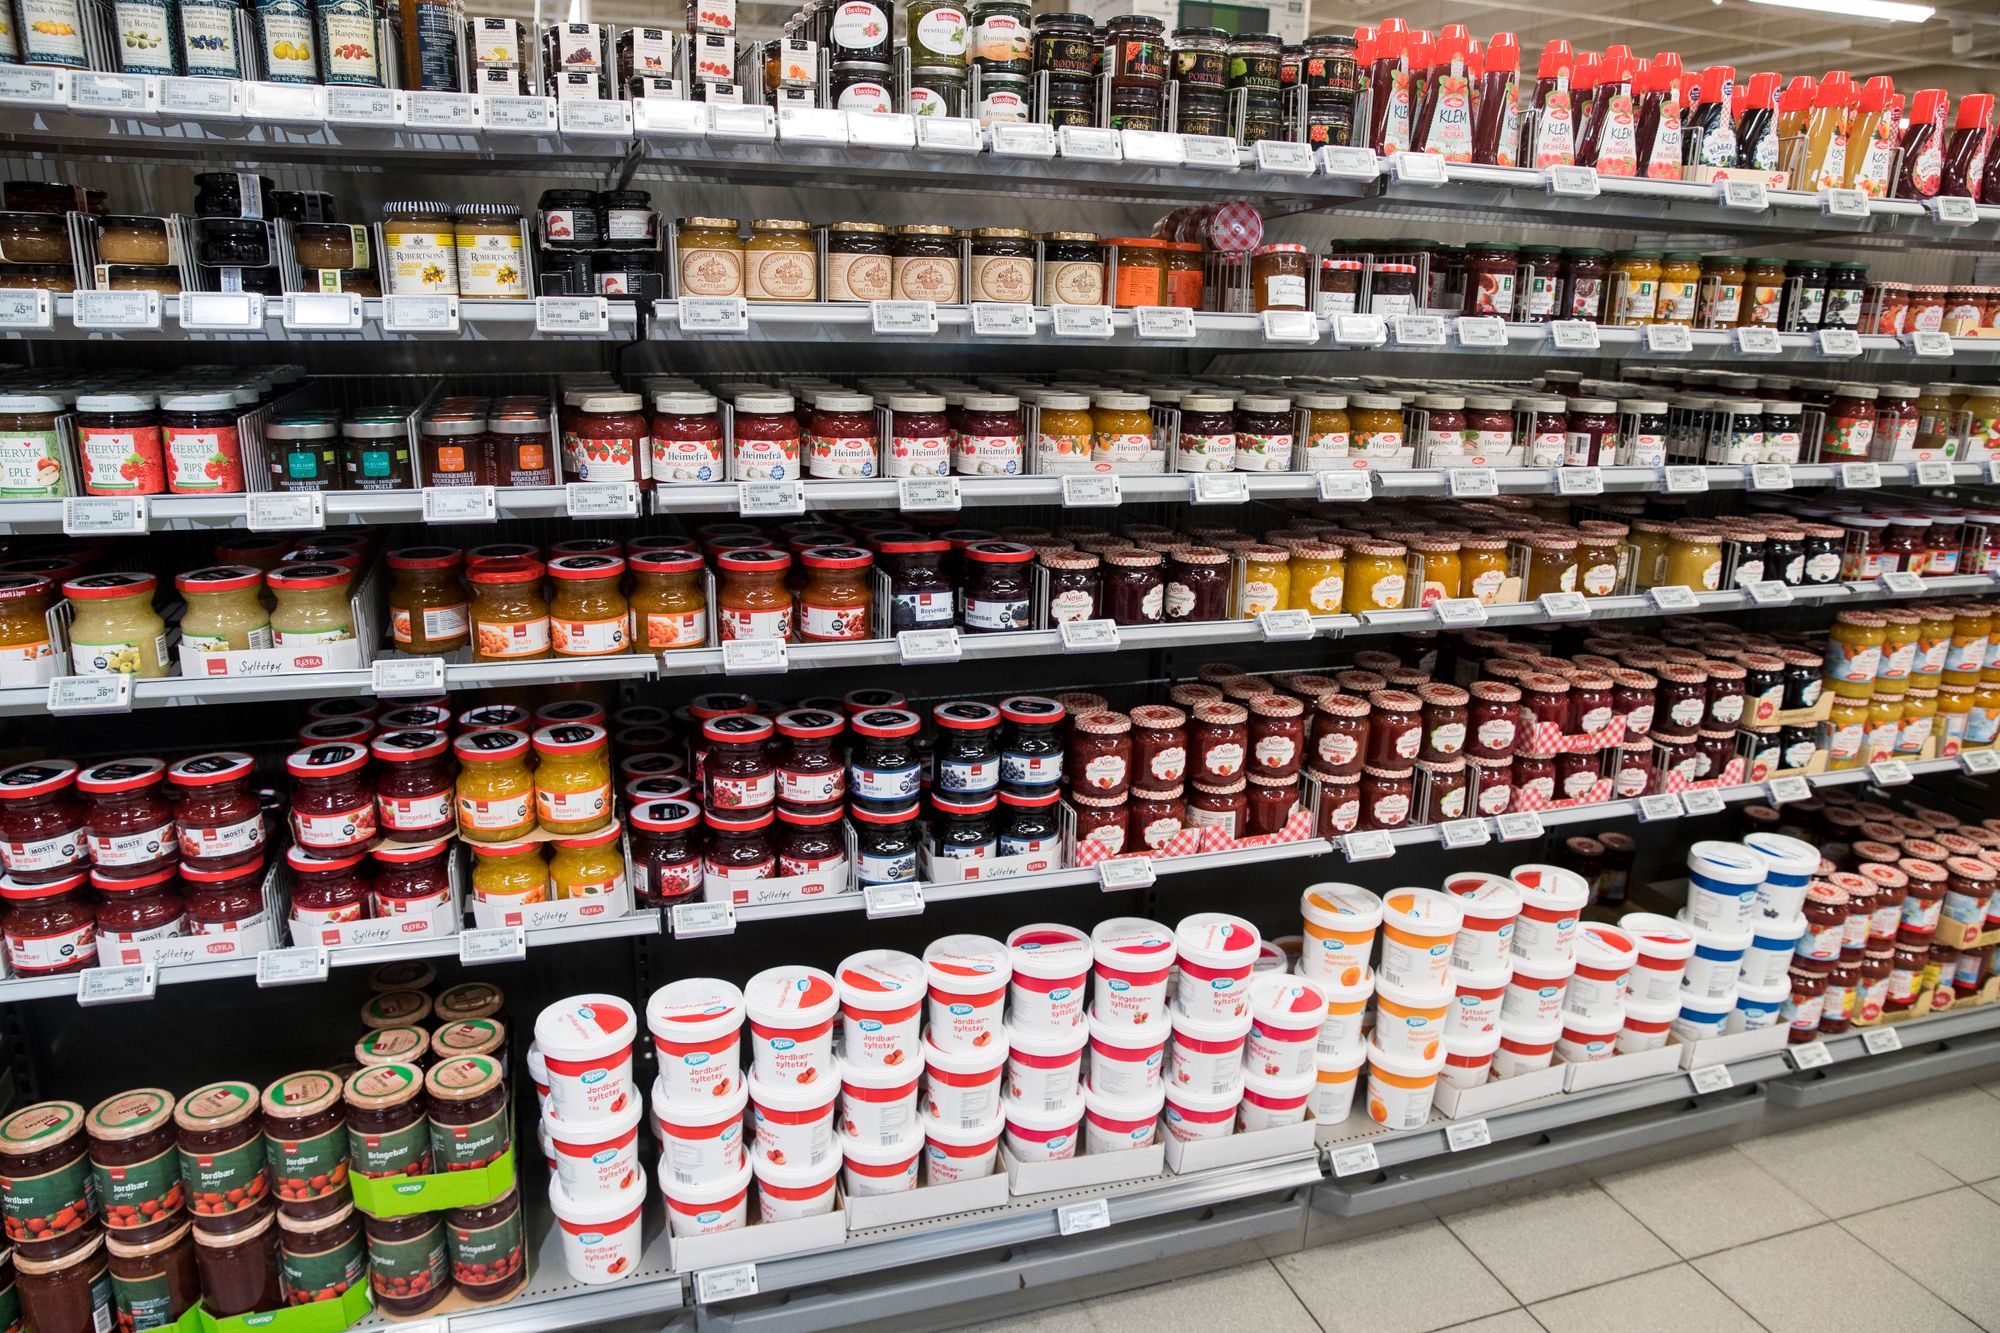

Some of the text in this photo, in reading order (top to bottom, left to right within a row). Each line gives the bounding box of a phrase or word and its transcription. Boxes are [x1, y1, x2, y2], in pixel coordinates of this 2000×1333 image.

[845, 5, 871, 16] Baxters
[936, 12, 960, 23] Baxters
[134, 20, 158, 29] Royale
[198, 21, 229, 33] Blueberry
[990, 20, 1014, 30] Baxters
[268, 29, 294, 39] Imperial
[335, 29, 369, 42] Raspberry
[854, 87, 880, 97] Baxters
[992, 95, 1017, 106] Baxters
[1439, 108, 1467, 124] KLEM
[1547, 123, 1570, 136] KLEM
[1610, 127, 1631, 140] KLEM
[88, 444, 129, 455] HERVIK
[172, 443, 213, 454] HERVIK
[833, 447, 871, 458] Heimefrå
[911, 447, 946, 457] Heimefrå
[979, 446, 1016, 458] Heimefrå
[668, 451, 708, 464] Heimefrå
[742, 449, 781, 461] Heimefrå
[8, 467, 32, 478] EPLE
[98, 463, 118, 473] RIPS
[183, 462, 203, 473] RIPS
[1247, 583, 1268, 593] Nora
[1063, 592, 1083, 603] Nora
[238, 661, 282, 673] Syltetøy
[295, 657, 321, 666] RØRA
[1267, 737, 1285, 746] Nora
[1163, 749, 1179, 758] Nora
[1216, 743, 1236, 753] Nora
[1096, 757, 1117, 767] Nora
[1154, 821, 1172, 831] Nora
[222, 828, 245, 839] MOSTE
[30, 844, 56, 855] MOSTE
[116, 840, 142, 851] MOSTE
[204, 841, 233, 849] Jordbær
[14, 856, 42, 864] Jordbær
[1027, 861, 1047, 871] RØRA
[986, 866, 1017, 880] Syltetøy
[802, 884, 823, 893] RØRA
[756, 889, 791, 902] Syltetøy
[581, 906, 603, 914] RØRA
[531, 910, 568, 925] Syltetøy
[403, 922, 427, 931] RØRA
[352, 928, 391, 943] Syltetøy
[208, 943, 233, 952] RØRA
[16, 953, 40, 961] Jordbær
[152, 948, 194, 961] Syltetøy
[1110, 1000, 1140, 1010] syltetøy
[953, 1024, 984, 1032] syltetøy
[863, 1041, 895, 1049] syltetøy
[775, 1060, 808, 1068] syltetøy
[690, 1073, 723, 1083] syltetøy
[587, 1093, 618, 1103] syltetøy
[455, 1134, 494, 1151] Bringebær
[368, 1145, 408, 1159] Bringebær
[285, 1154, 318, 1166] Jordbær
[201, 1168, 235, 1180] Jordbær
[113, 1181, 148, 1193] Jordbær
[397, 1184, 422, 1193] coop
[3, 1194, 34, 1204] Jordbær
[458, 1242, 496, 1254] Bringebær
[584, 1250, 618, 1261] syltetøy
[247, 1316, 273, 1325] coop
